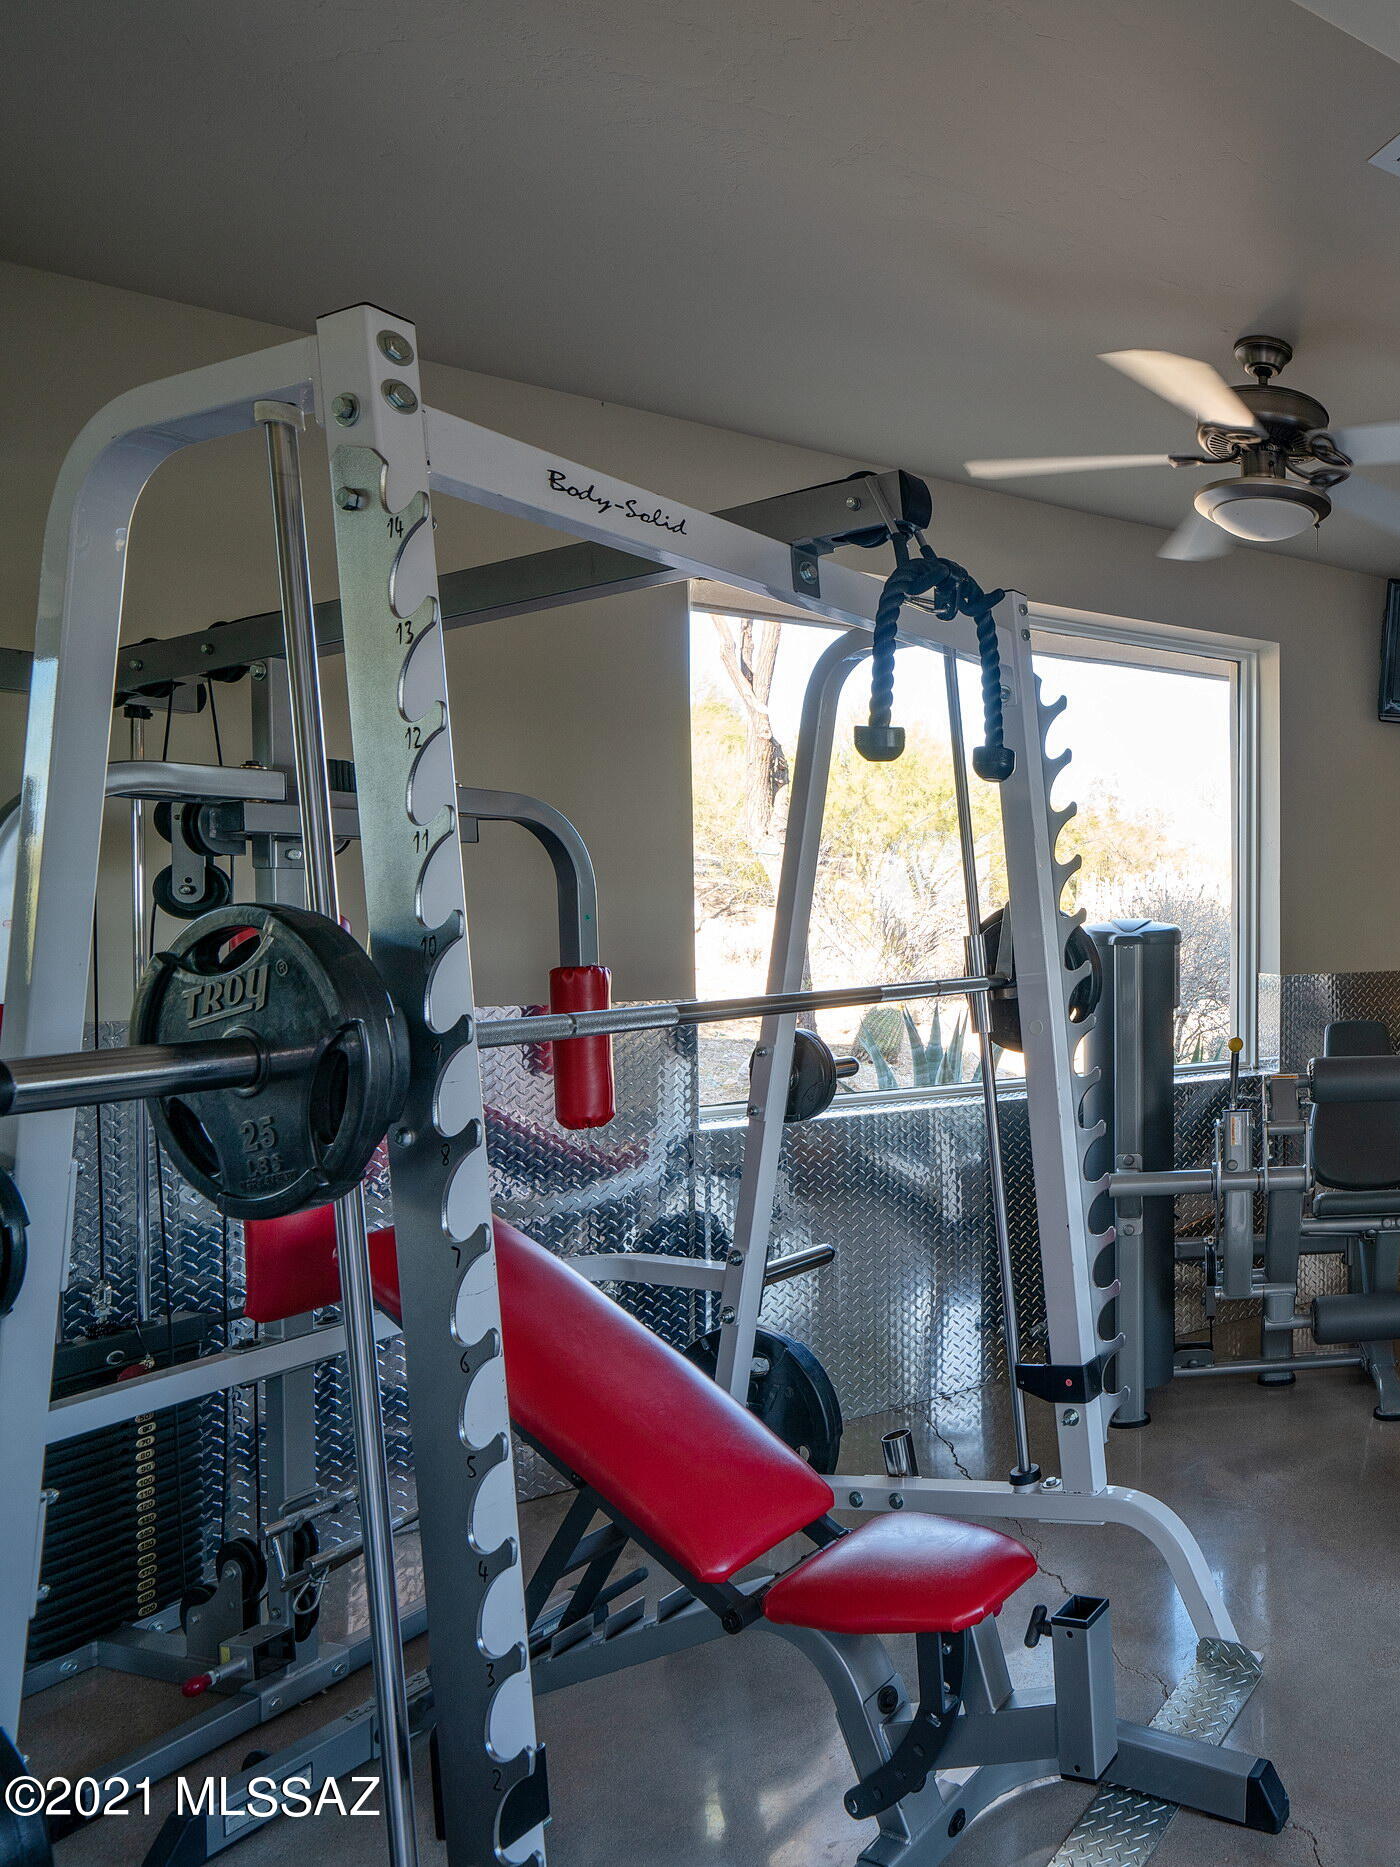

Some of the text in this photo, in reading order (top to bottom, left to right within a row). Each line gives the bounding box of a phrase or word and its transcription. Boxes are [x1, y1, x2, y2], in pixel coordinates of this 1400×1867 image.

[547, 469, 687, 535] Body-Solid
[387, 517, 404, 539] 14
[395, 620, 414, 645] 13
[405, 726, 422, 749] 12
[412, 828, 429, 853] 11
[421, 934, 437, 958] 10
[240, 1115, 277, 1153] 25
[440, 1143, 450, 1166] 8
[451, 1245, 461, 1269] 7
[460, 1351, 470, 1374] 6
[466, 1455, 477, 1478] 5
[478, 1560, 489, 1583] 4
[486, 1662, 496, 1687] 3
[492, 1768, 502, 1792] 2
